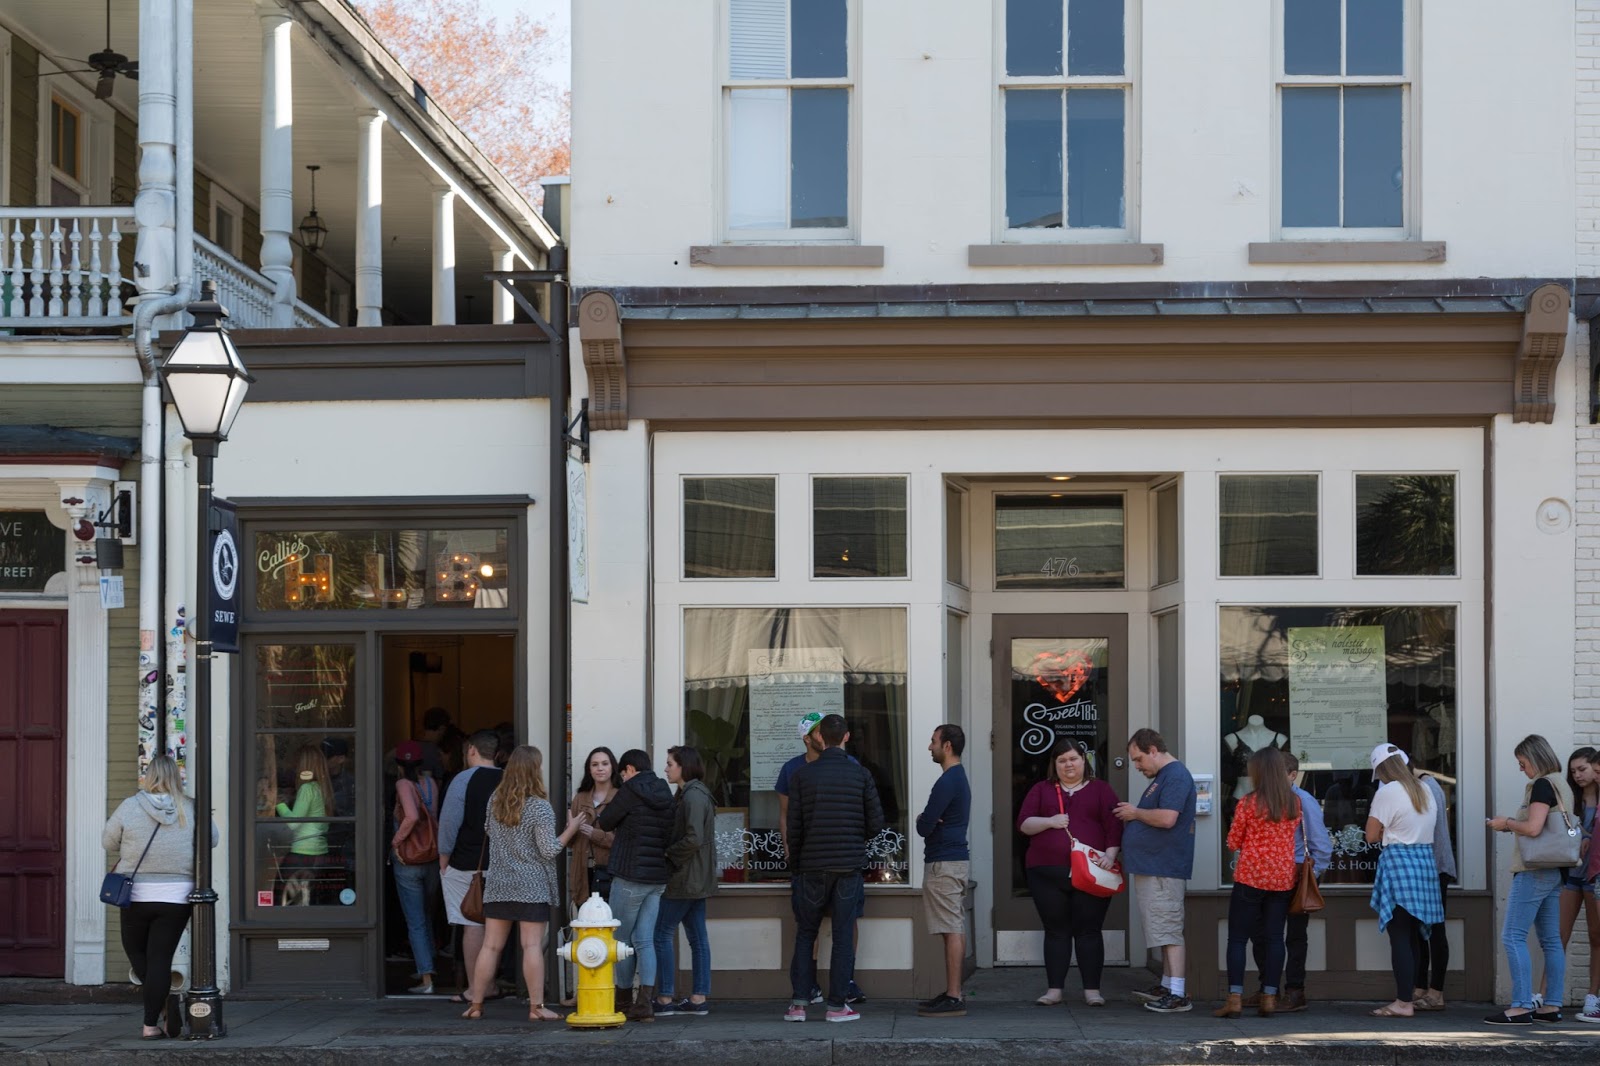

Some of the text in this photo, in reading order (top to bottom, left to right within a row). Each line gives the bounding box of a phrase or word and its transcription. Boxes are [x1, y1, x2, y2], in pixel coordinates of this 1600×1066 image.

[258, 534, 311, 580] Callie's
[0, 566, 34, 578] REET
[1041, 557, 1080, 578] 476
[214, 609, 235, 624] SEWE
[1331, 633, 1364, 648] holistic
[1342, 647, 1377, 664] massage
[294, 698, 318, 714] Fresh!
[717, 859, 909, 872] RING STUDIO UTIQUE
[1337, 859, 1347, 871] &
[1349, 860, 1377, 871] HOLI
